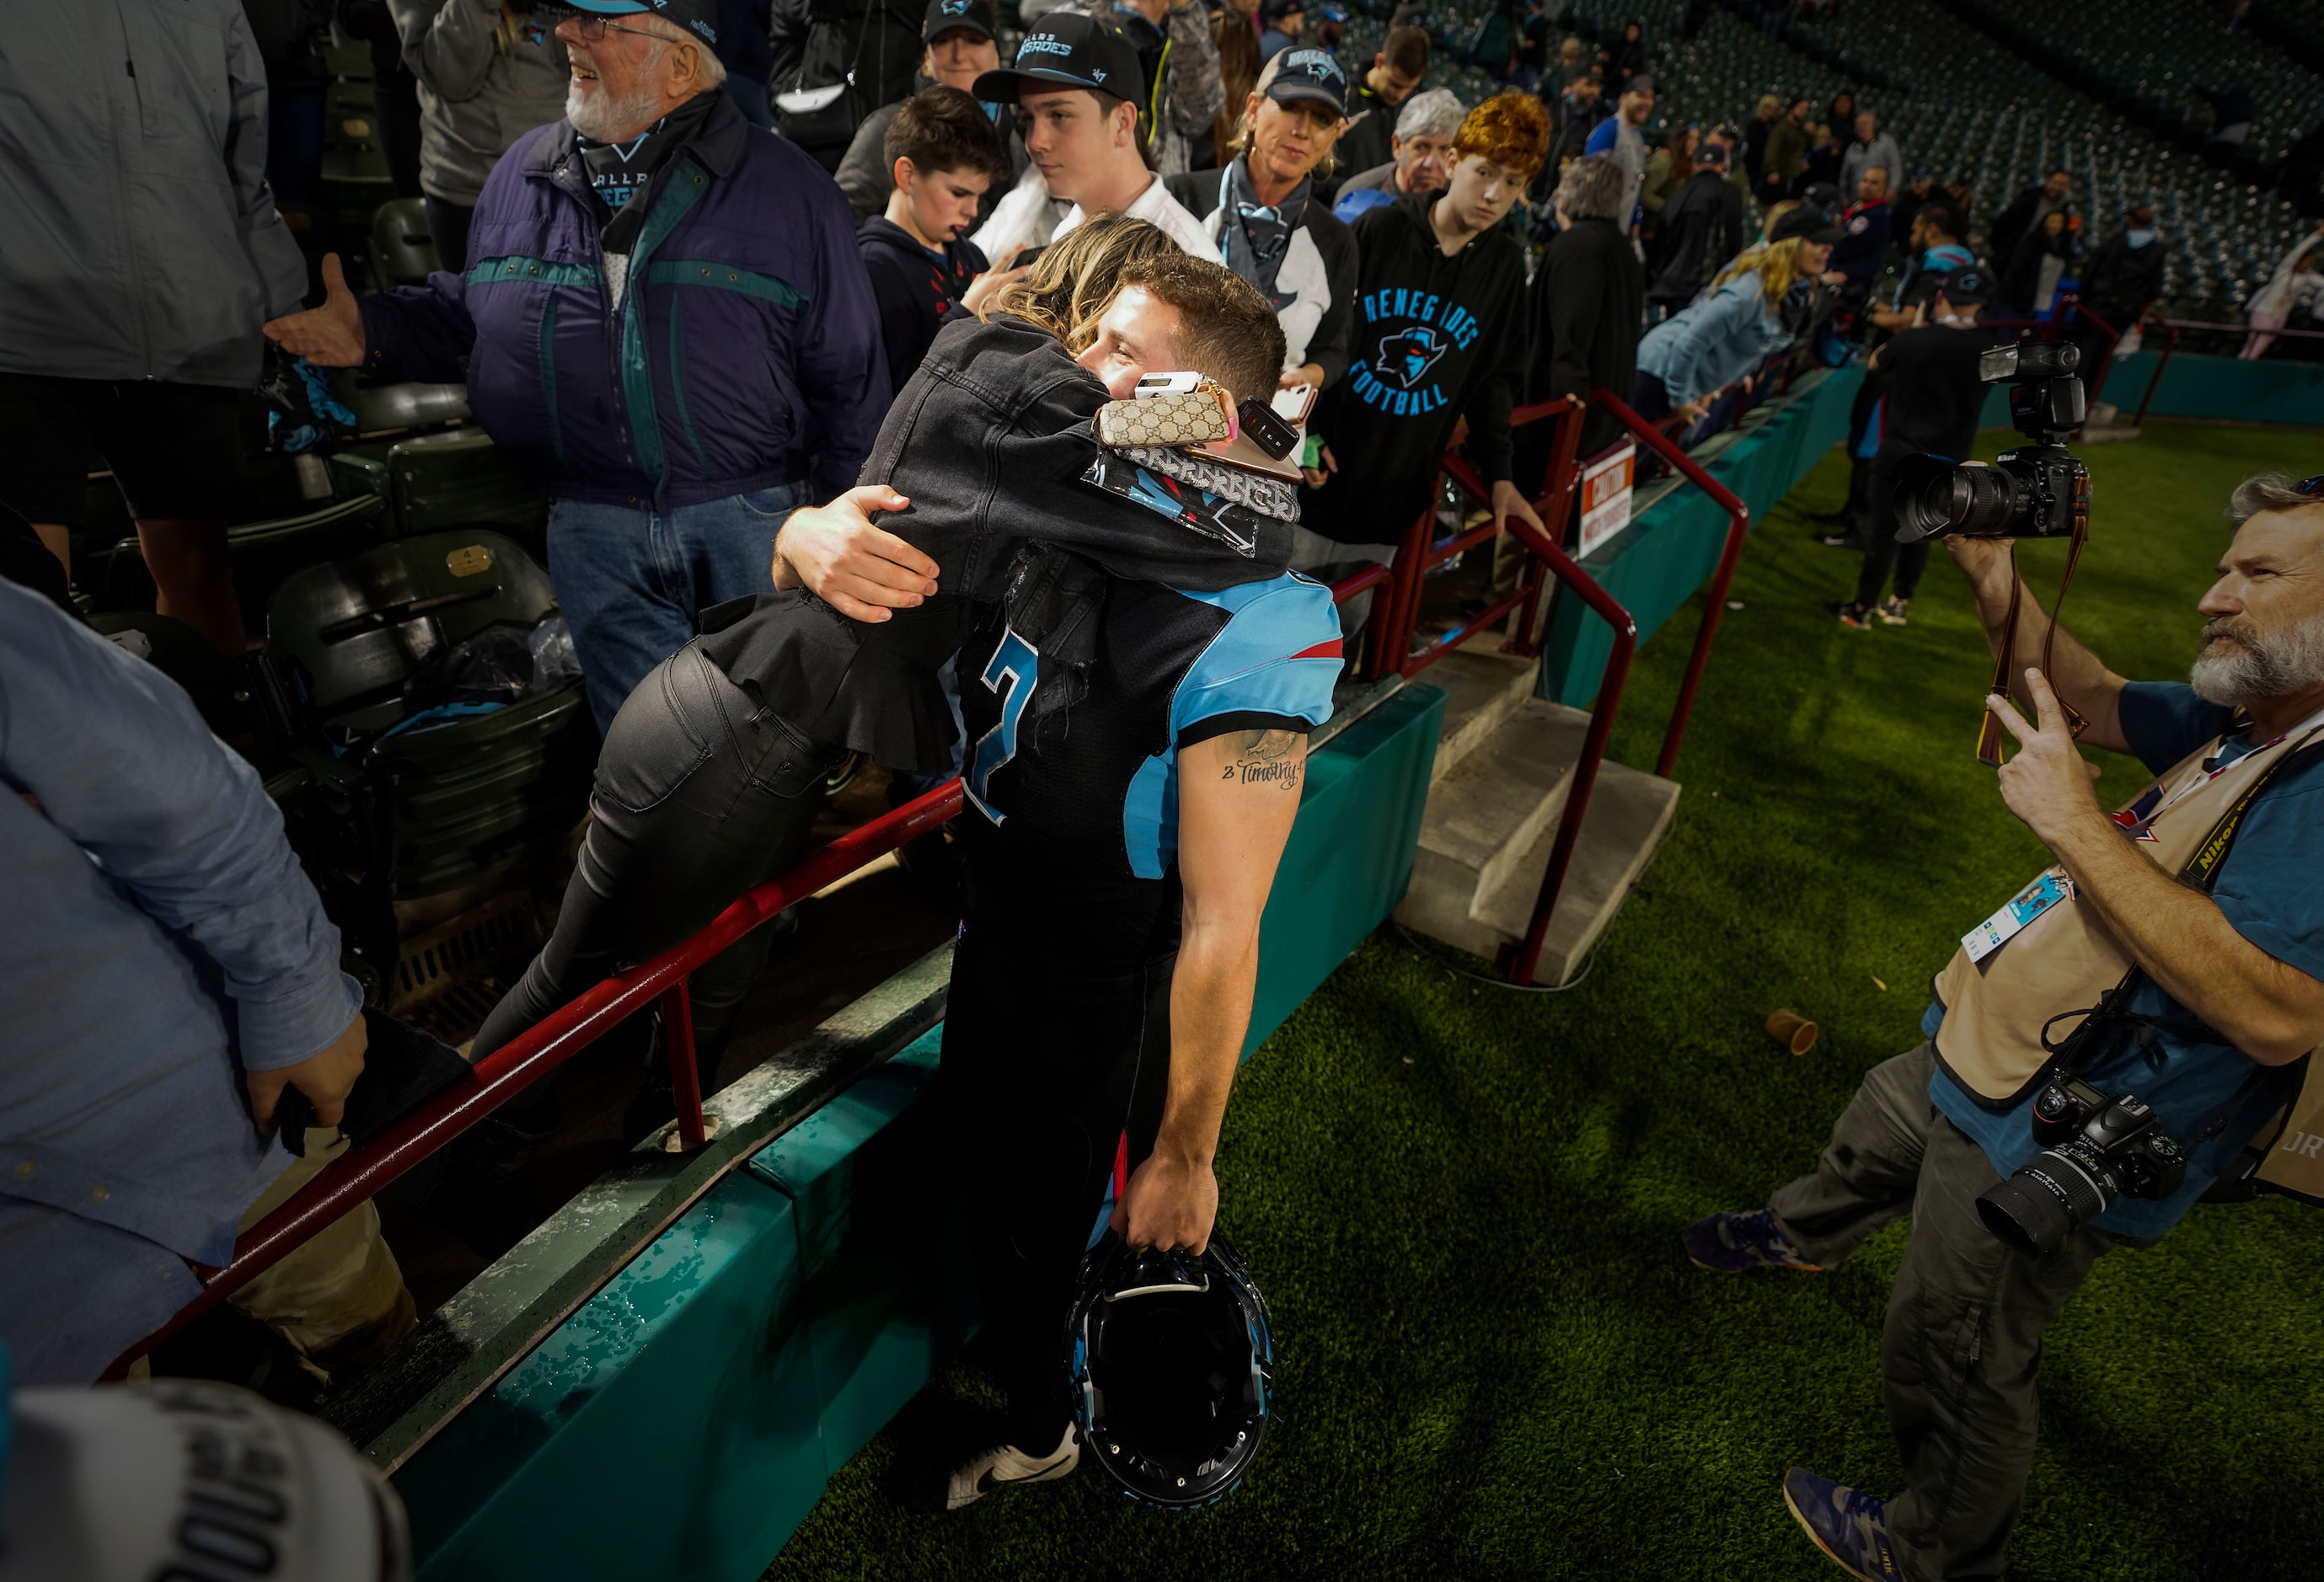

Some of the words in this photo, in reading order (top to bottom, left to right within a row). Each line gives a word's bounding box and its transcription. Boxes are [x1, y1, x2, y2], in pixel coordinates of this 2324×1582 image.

[1023, 32, 1056, 45] LLAS
[1016, 40, 1073, 62] GADES
[1348, 358, 1449, 416] FOOTBALL
[1237, 760, 1299, 790] Timothy
[2078, 1133, 2106, 1155] Nikon
